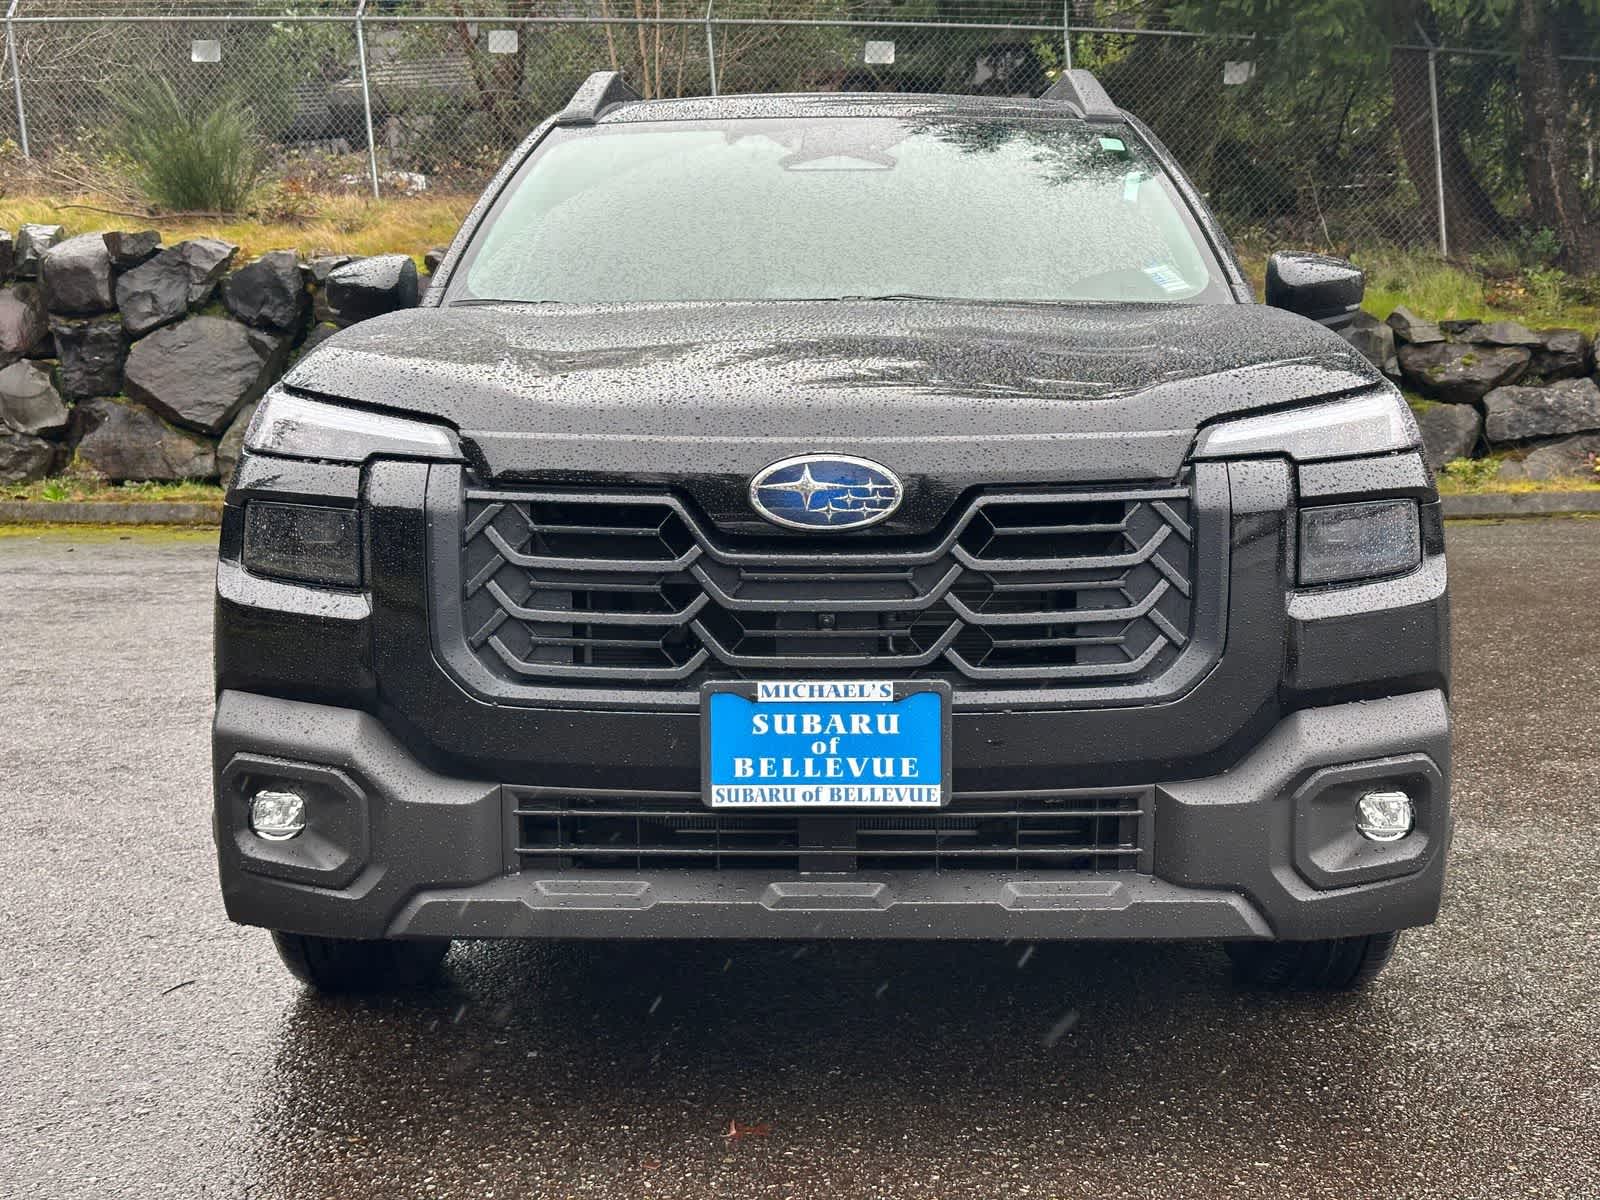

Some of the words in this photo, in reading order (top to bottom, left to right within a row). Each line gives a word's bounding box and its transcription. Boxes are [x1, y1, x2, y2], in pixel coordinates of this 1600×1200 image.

[760, 684, 892, 698] MICHAEL'S
[751, 713, 900, 735] SUBARU
[811, 737, 840, 755] of
[733, 757, 919, 778] BELLEVUE
[715, 787, 795, 803] SUBARU
[801, 786, 822, 803] of
[829, 787, 938, 803] BELLEVUE
